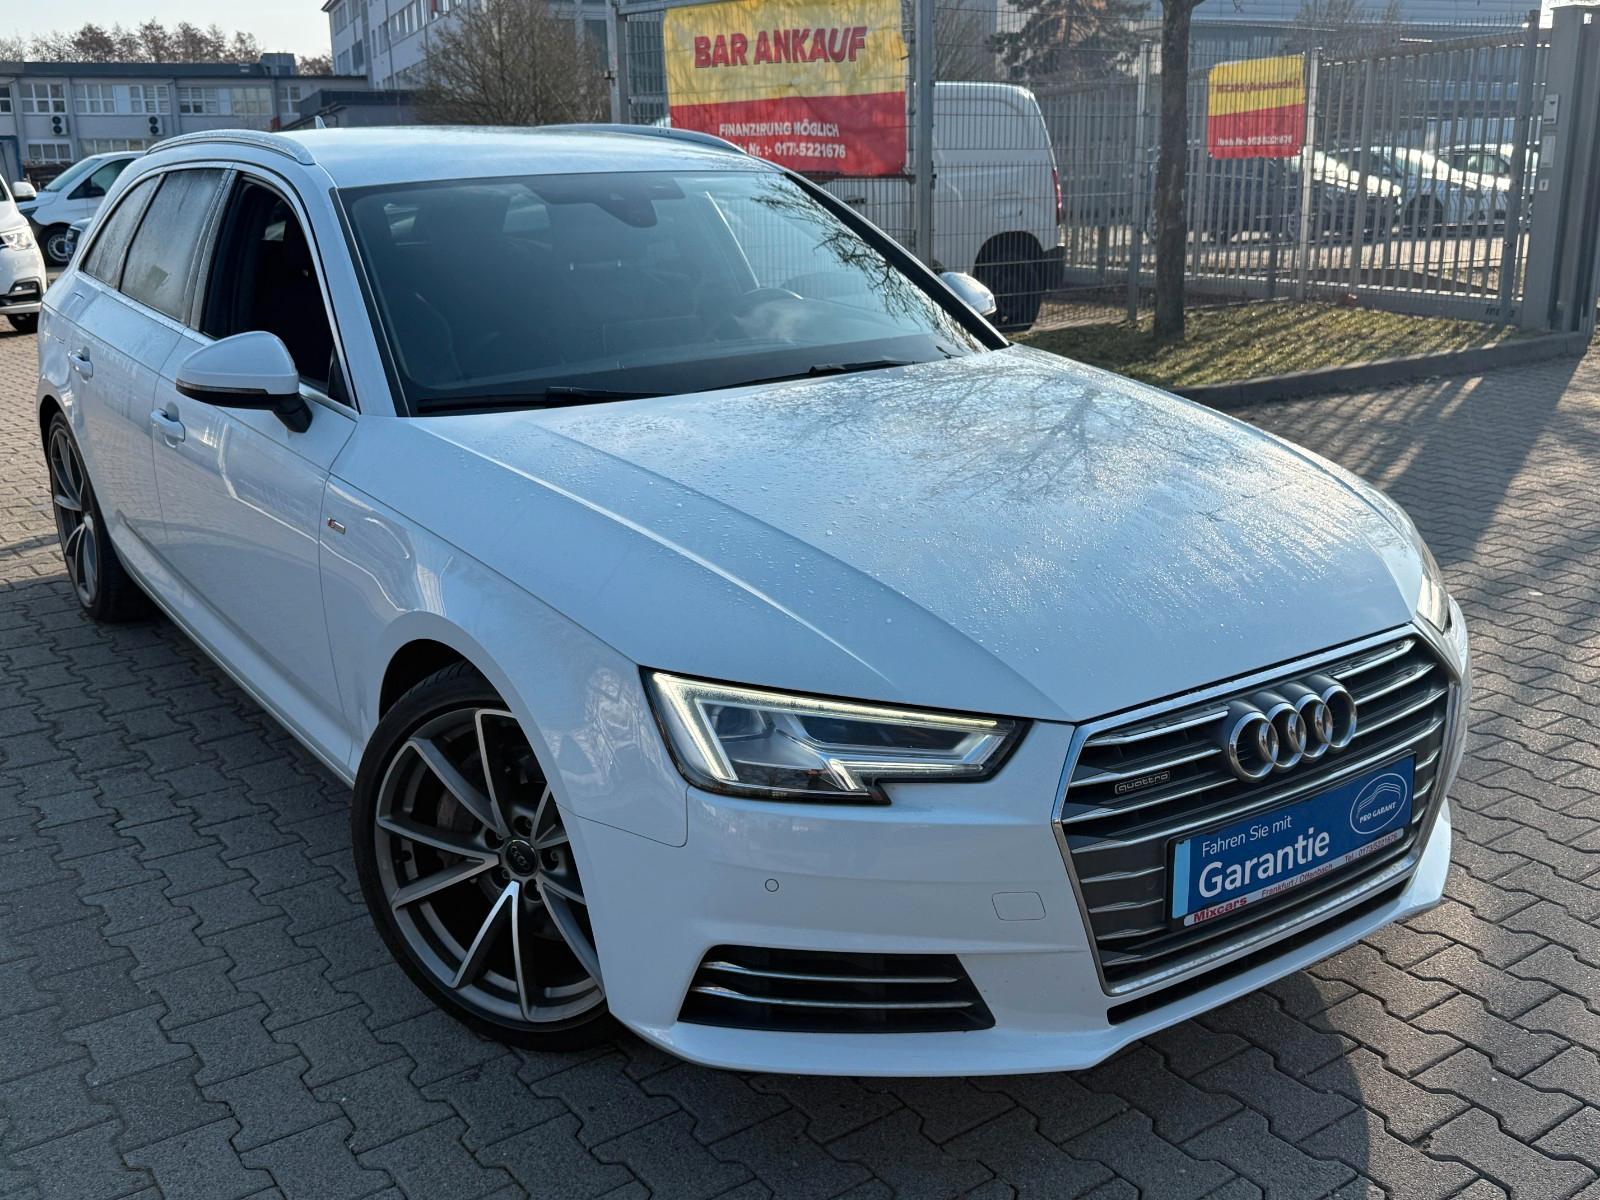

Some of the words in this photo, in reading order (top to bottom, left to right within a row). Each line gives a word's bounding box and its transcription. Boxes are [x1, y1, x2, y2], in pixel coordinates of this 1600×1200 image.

[694, 33, 748, 69] BAR
[754, 26, 868, 65] ANKAUF
[719, 122, 792, 137] FINANZIRUNG
[1118, 773, 1169, 793] quattro
[1359, 812, 1372, 824] PRO
[1372, 801, 1397, 817] GARANT
[1202, 833, 1246, 858] Fahren
[1249, 824, 1269, 841] Sie
[1272, 815, 1292, 834] mit
[1198, 826, 1330, 898] Garantie
[1193, 897, 1248, 923] Mixcars
